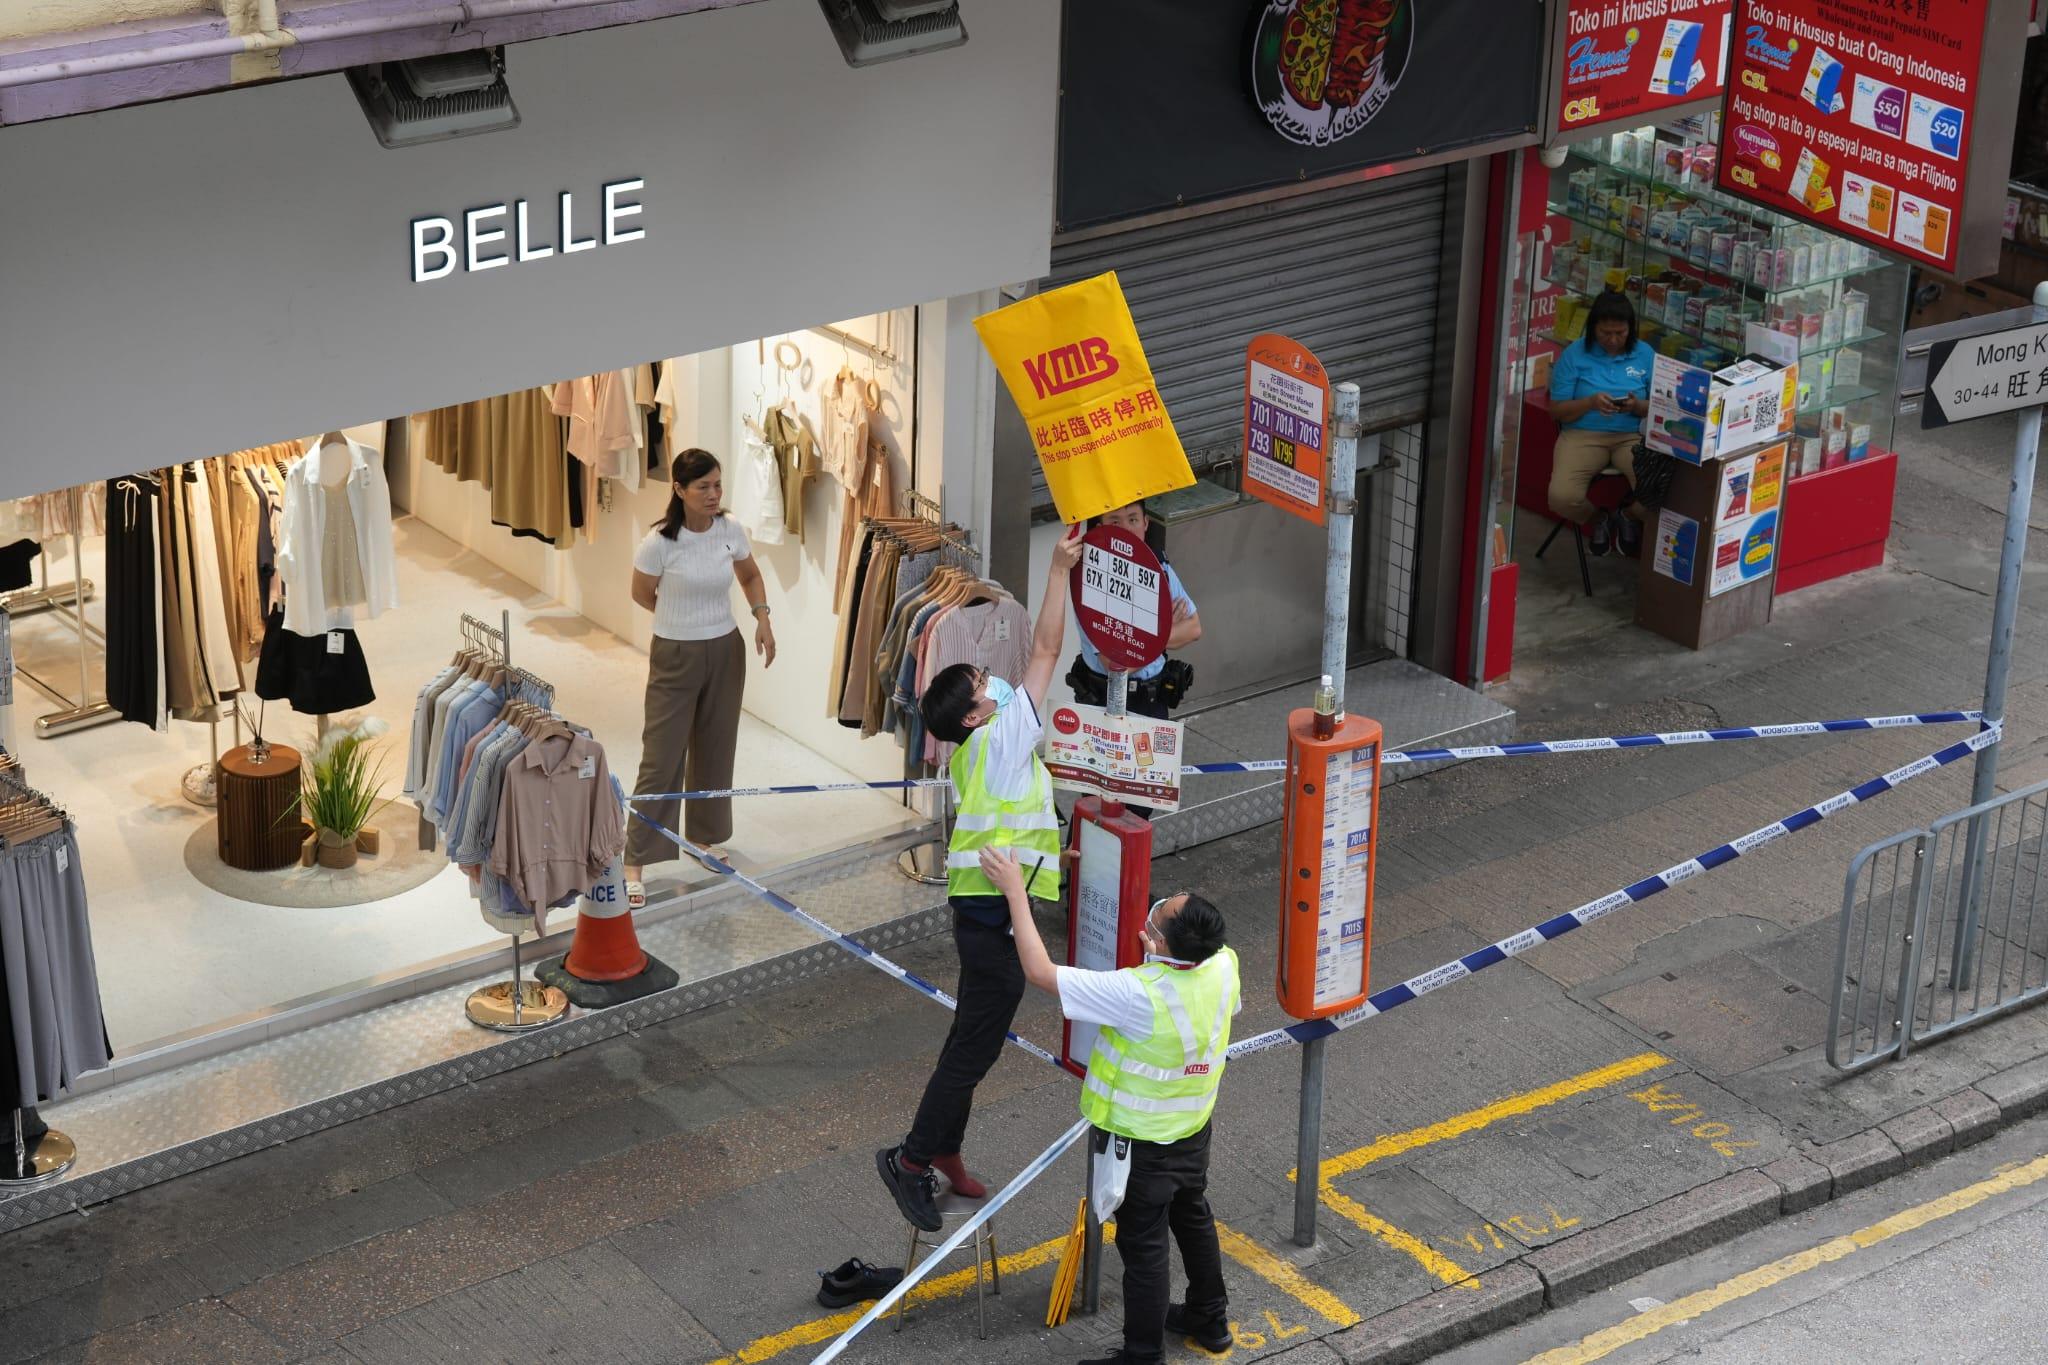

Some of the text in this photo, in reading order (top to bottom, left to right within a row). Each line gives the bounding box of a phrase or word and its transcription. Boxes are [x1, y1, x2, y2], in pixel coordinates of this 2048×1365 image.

[1569, 9, 1599, 35] Toko
[1603, 4, 1618, 28] ini
[1622, 0, 1667, 23] khusus
[1858, 20, 1874, 35] and
[1870, 10, 1889, 26] Data
[1891, 16, 1921, 38] Prepaid
[1922, 27, 1940, 44] SIM
[1941, 33, 1962, 50] Card
[1568, 37, 1632, 75] Hemat
[1747, 1, 1967, 93] Toko ini khusus buat Orang Indonesia
[1741, 69, 1768, 93] CSL
[1564, 96, 1600, 122] CSL
[1877, 99, 1900, 118] $50
[1270, 103, 1312, 143] PIZZA
[1316, 126, 1329, 145] &
[1934, 119, 1957, 139] $20
[1733, 94, 1957, 192] Ang shop na ito ay espesyal para sa mga Filipino
[1738, 127, 1777, 150] Kumusta
[1763, 152, 1778, 165] Ka
[1731, 165, 1758, 188] CSL
[1870, 198, 1886, 211] $50
[410, 177, 645, 282] BELLE
[1976, 344, 2028, 367] Mong
[1022, 336, 1120, 400] KMB
[1280, 388, 1295, 400] Street
[1296, 394, 1314, 409] Market
[1954, 382, 1999, 405] 30-44
[1036, 389, 1159, 449] 此站臨時停用
[1252, 401, 1270, 427] 701
[1275, 411, 1294, 438] 701A
[1042, 415, 1164, 465] This stop suspended temporarily
[1251, 428, 1269, 454] 793
[1299, 420, 1320, 448] 701S
[1273, 438, 1293, 465] N796
[1088, 547, 1099, 566] 44
[1111, 537, 1135, 557] KMB
[1086, 567, 1102, 589] 67X
[1112, 557, 1129, 579] 58X
[1138, 568, 1155, 589] 59X
[1109, 579, 1132, 601] 272X
[1092, 621, 1145, 650] MONG KOK ROAD
[1104, 616, 1135, 638] 旺角道
[1058, 714, 1076, 723] club
[1762, 724, 1819, 736] POLICE CORDON
[1356, 748, 1371, 760] 701
[1889, 768, 1908, 781] POLICE
[1350, 832, 1368, 844] 701A
[1736, 835, 1757, 849] POLICE
[1577, 902, 1598, 917] POLICE
[1344, 921, 1362, 935] 701S
[1411, 973, 1432, 988] POLICE
[1421, 969, 1467, 992] DO NOT CROSS
[1228, 1041, 1253, 1055] POLICE
[1184, 1063, 1209, 1075] KMB
